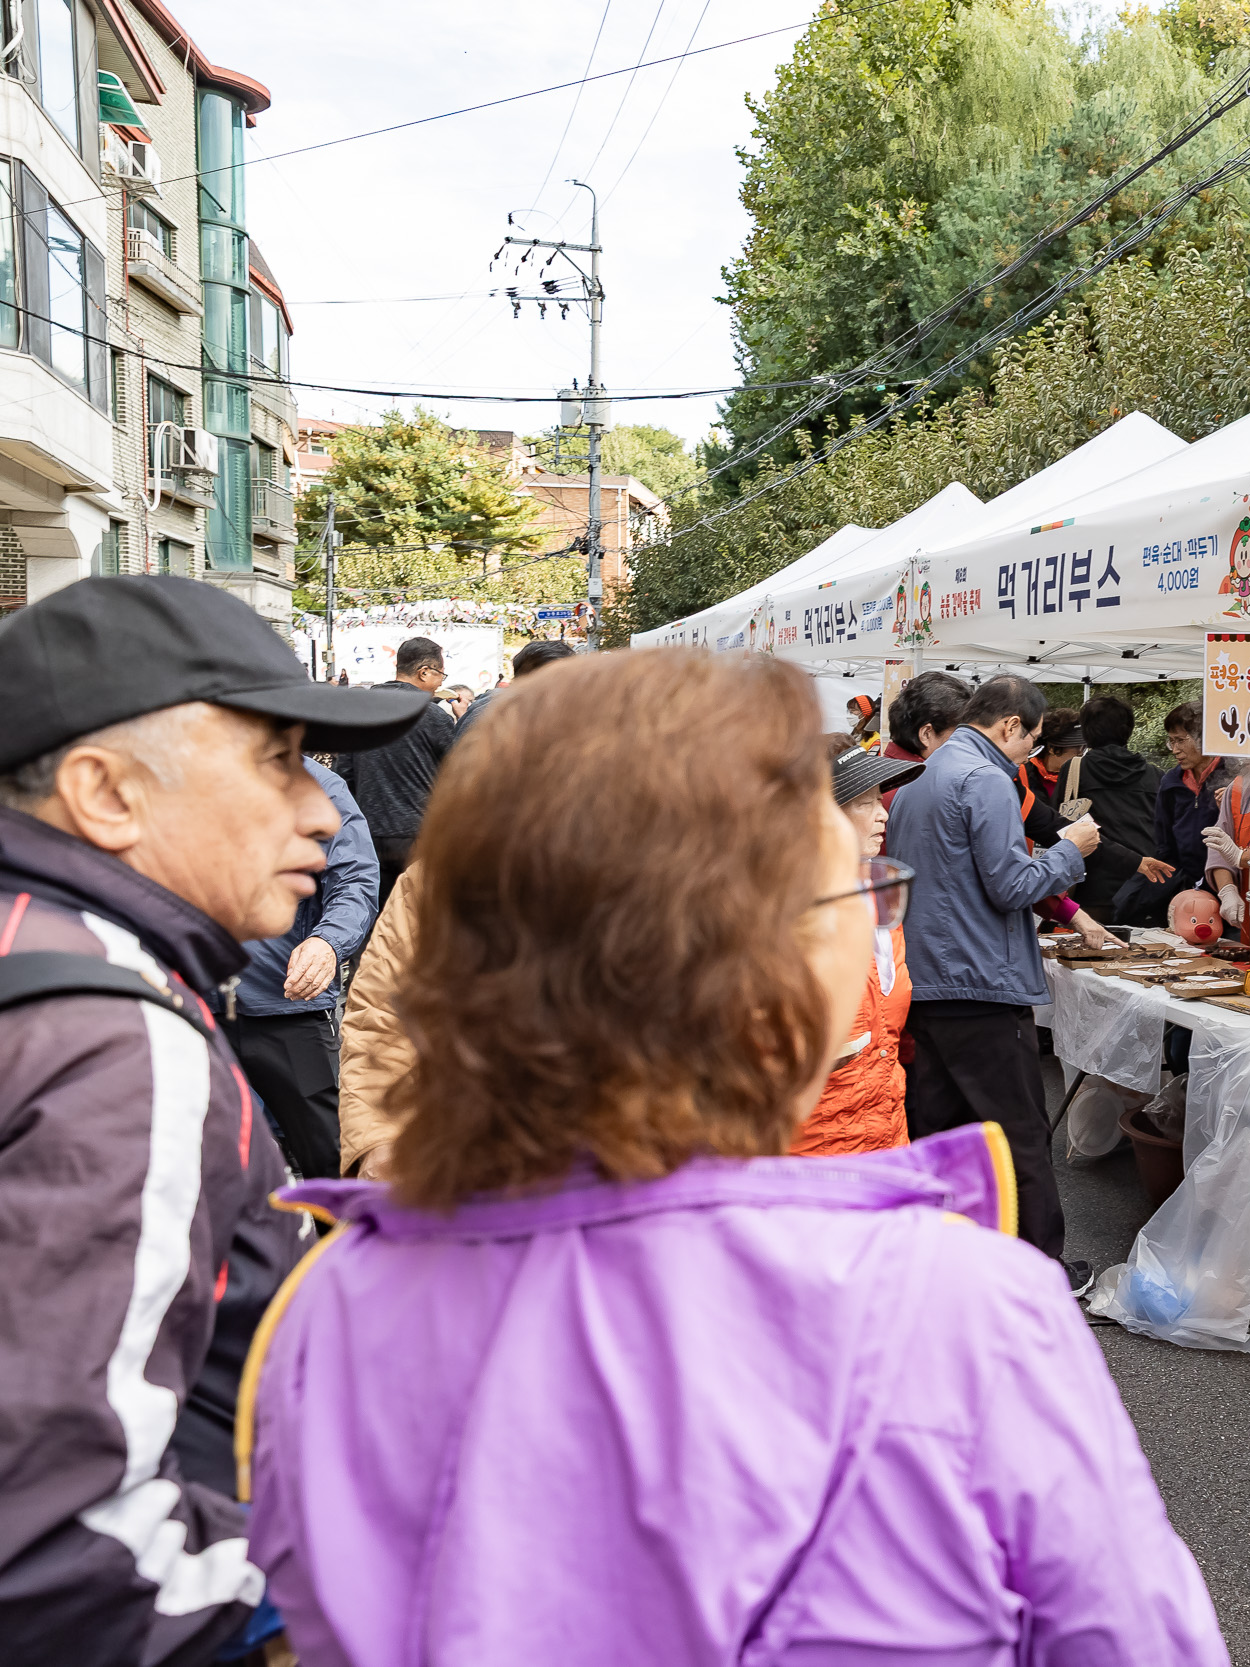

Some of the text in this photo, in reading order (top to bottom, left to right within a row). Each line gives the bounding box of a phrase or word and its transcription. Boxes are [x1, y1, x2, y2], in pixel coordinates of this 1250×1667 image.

[997, 544, 1122, 620] 먹거리부스
[1157, 566, 1199, 595] 4,000원
[804, 600, 858, 647] 먹거리부스
